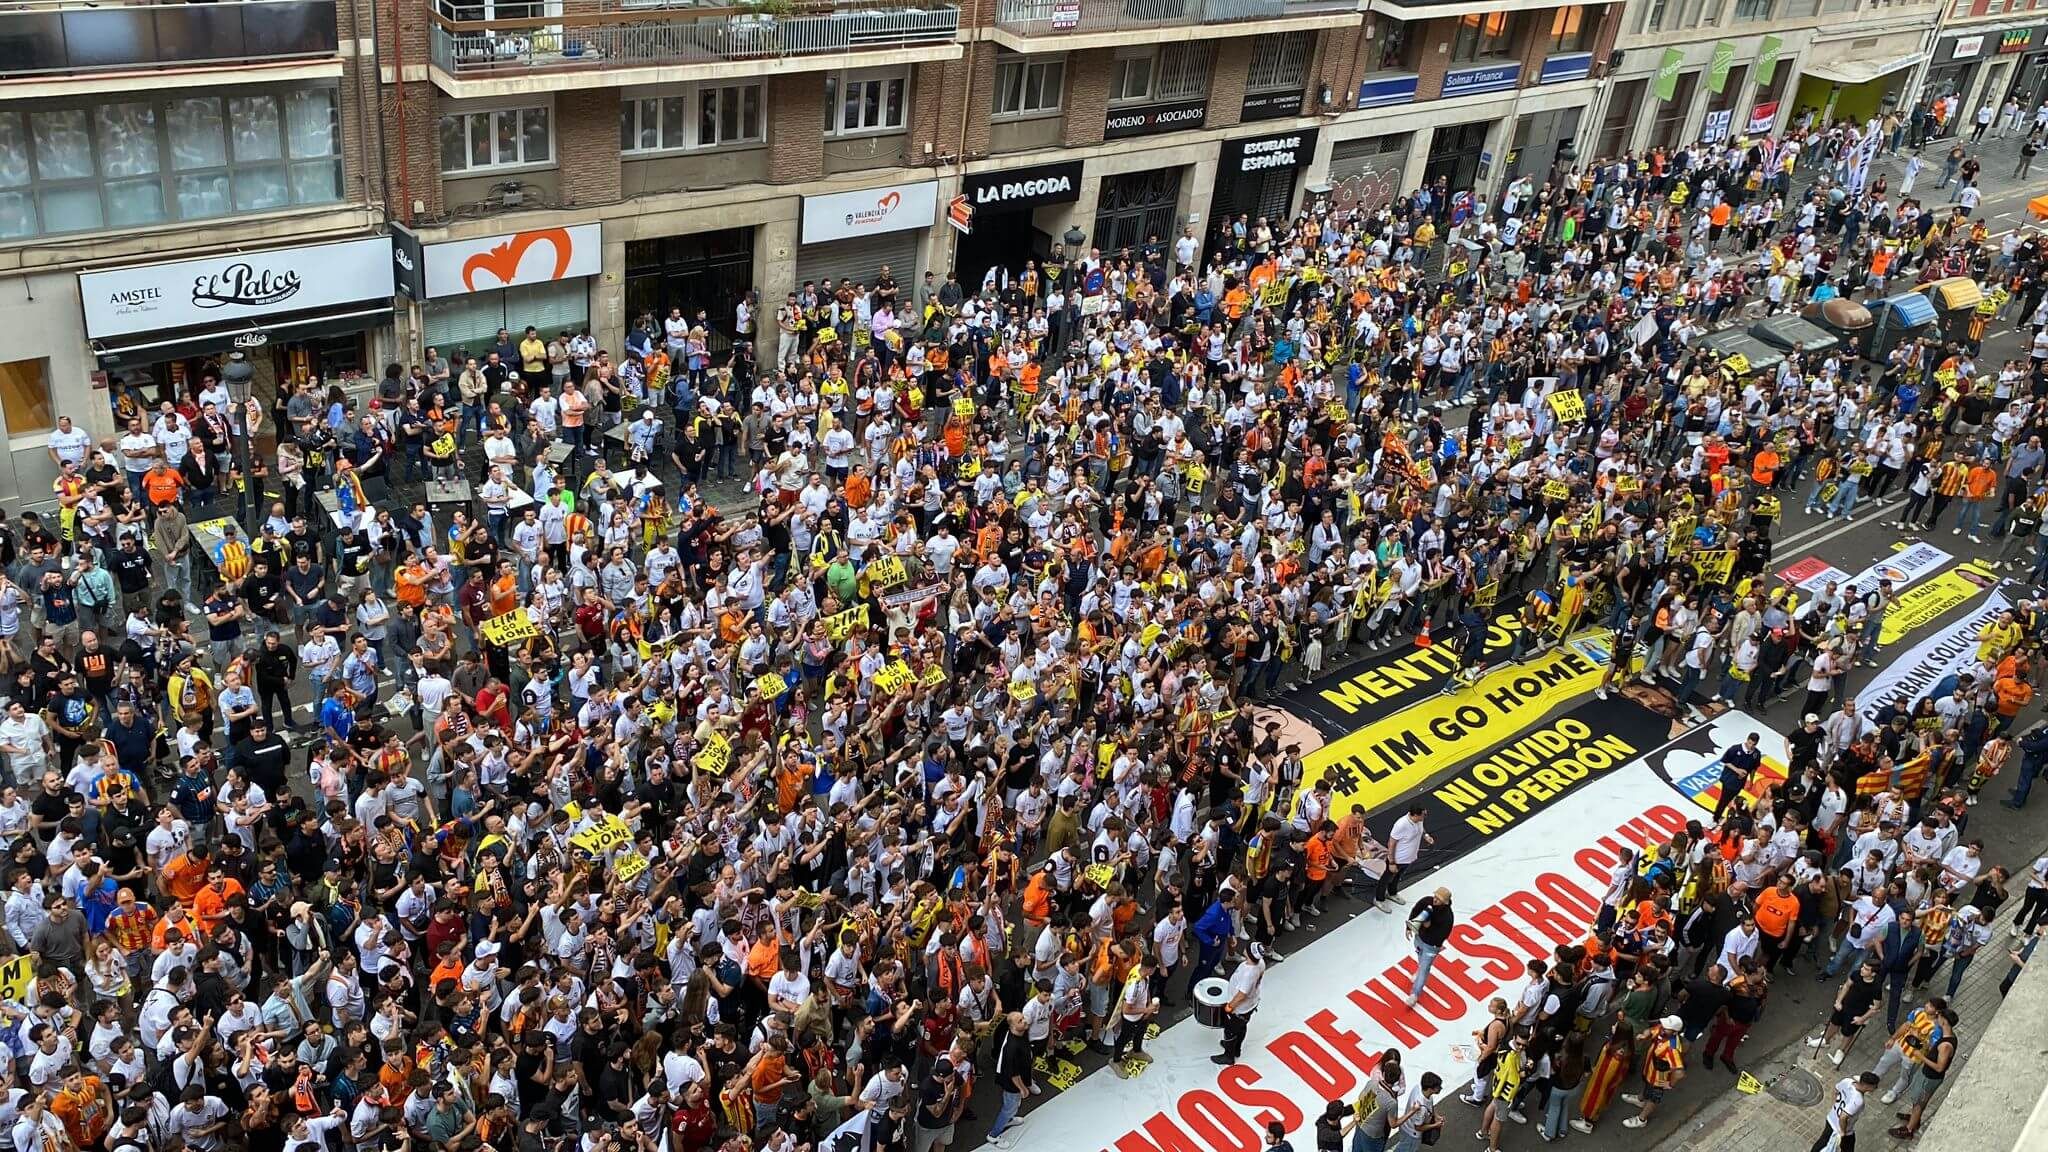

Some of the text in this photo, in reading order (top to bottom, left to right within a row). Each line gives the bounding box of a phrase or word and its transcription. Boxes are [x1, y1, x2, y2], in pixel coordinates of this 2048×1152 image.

[1446, 70, 1504, 86] Solmar Finance
[1106, 108, 1204, 129] MORENO ASOCIADOS
[1244, 137, 1301, 154] ESCUELA DE
[1241, 151, 1297, 171] ESPAÑOL
[977, 175, 1071, 203] LA PAGODA
[1505, 225, 1515, 236] 27
[192, 263, 300, 299] El Palco
[110, 287, 162, 304] AMSTEL
[1554, 391, 1577, 403] LIM
[1565, 401, 1577, 409] GO
[1560, 407, 1585, 420] HOM
[875, 557, 895, 571] LIM
[882, 569, 893, 578] GO
[882, 571, 905, 587] OME
[490, 611, 517, 629] LIM
[502, 622, 516, 632] GO
[833, 608, 860, 628] LIM
[495, 626, 534, 644] HOME
[878, 661, 898, 676] LIM
[886, 672, 916, 690] HOME
[1333, 653, 1598, 797] #LIM GO HOME
[1432, 718, 1592, 813] NI OLVIDO
[1465, 733, 1638, 836] NI PERDÓN
[581, 815, 610, 838] LIM
[590, 829, 630, 851] HOME
[1265, 1008, 1384, 1101] DE
[1346, 872, 1602, 1050] NUESTRO
